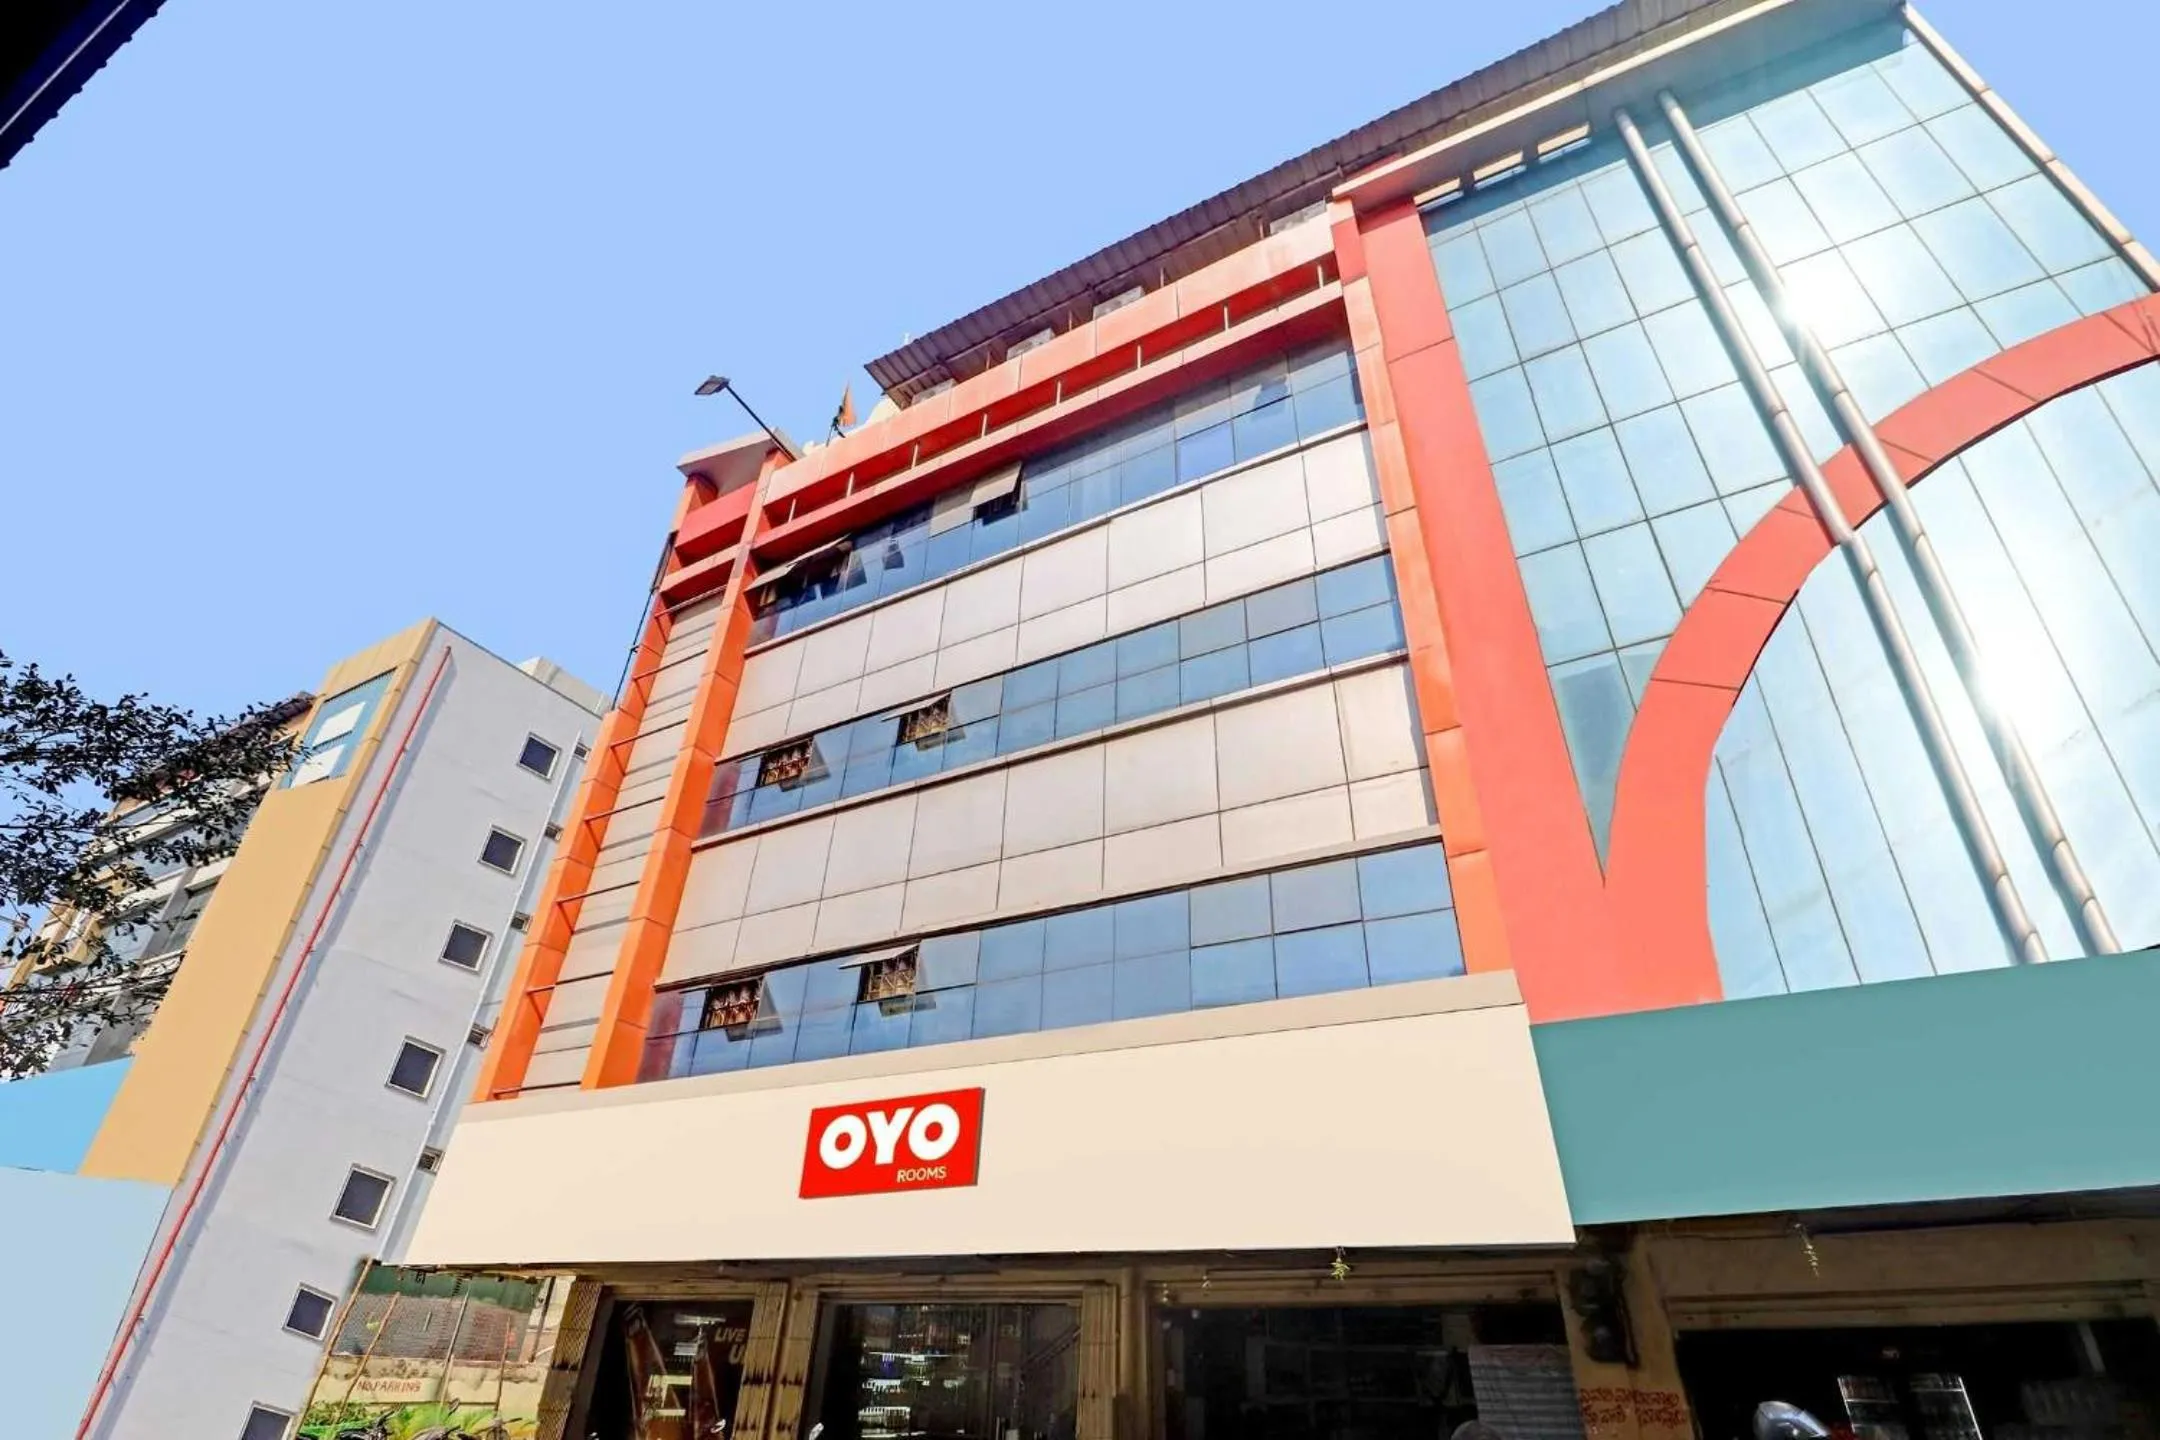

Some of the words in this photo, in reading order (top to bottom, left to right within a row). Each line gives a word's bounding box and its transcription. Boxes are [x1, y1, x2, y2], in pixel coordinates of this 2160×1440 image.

[819, 1103, 960, 1170] OYO
[896, 1166, 947, 1184] ROOMS
[714, 1327, 746, 1343] LIVE
